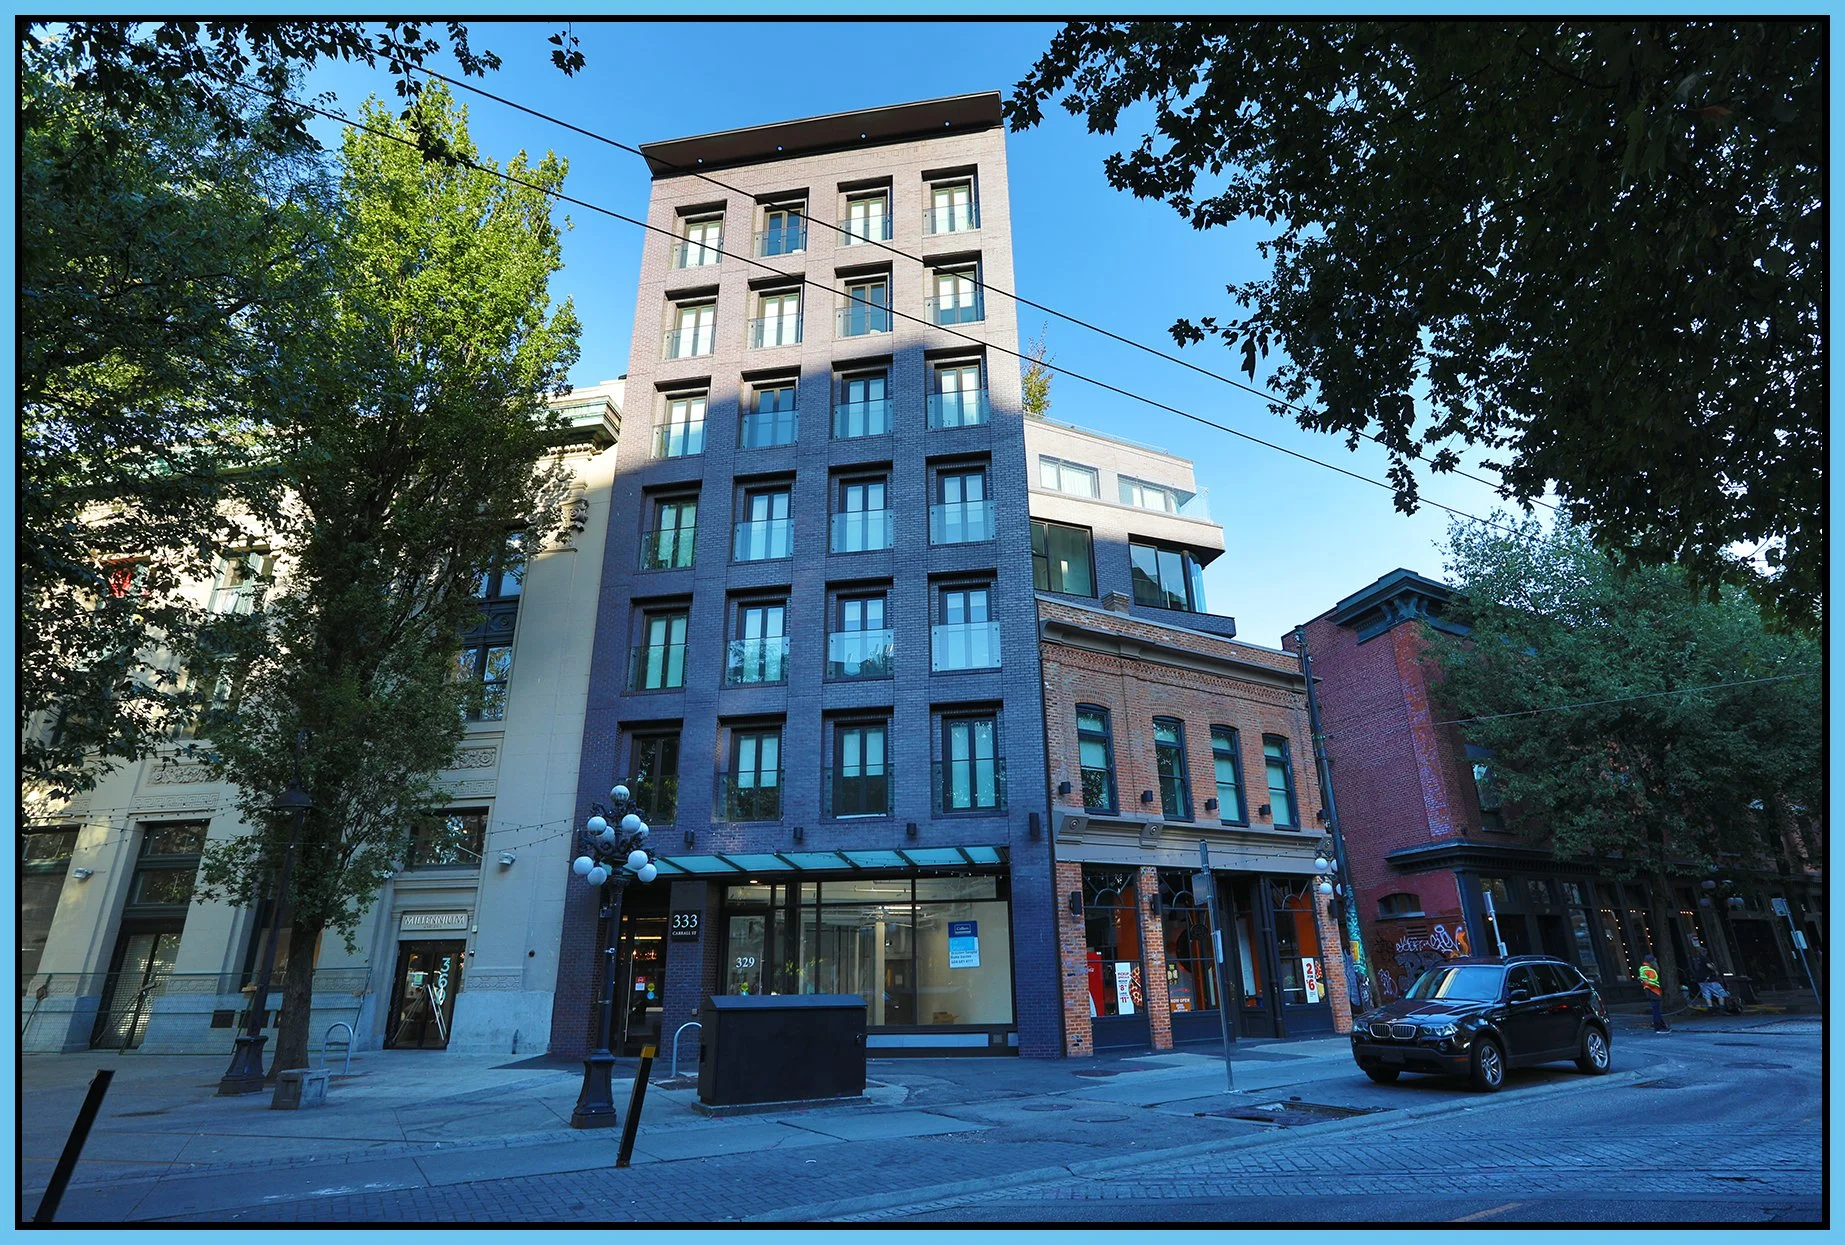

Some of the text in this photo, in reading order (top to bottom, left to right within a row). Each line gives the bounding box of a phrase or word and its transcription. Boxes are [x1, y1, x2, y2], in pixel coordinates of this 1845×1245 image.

[404, 915, 465, 926] MILLENNIUM
[672, 914, 698, 929] 333
[735, 956, 755, 969] 329
[1306, 962, 1313, 975] 2
